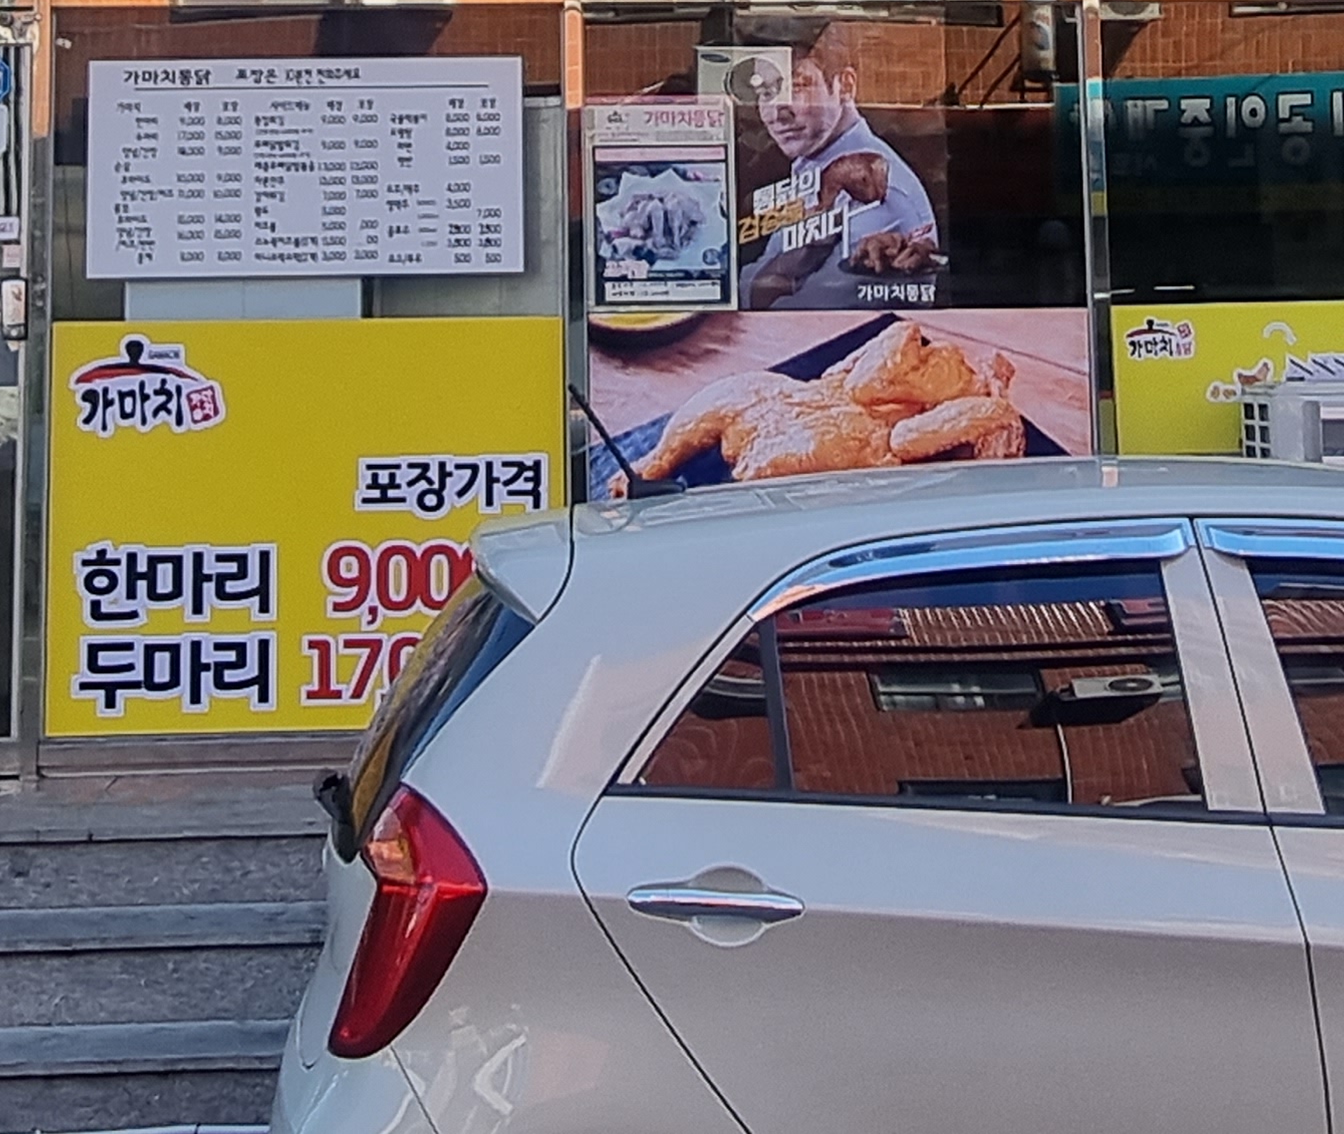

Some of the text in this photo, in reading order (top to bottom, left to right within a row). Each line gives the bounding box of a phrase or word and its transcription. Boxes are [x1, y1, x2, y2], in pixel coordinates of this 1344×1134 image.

[123, 68, 212, 86] 가마치통닭
[857, 282, 937, 302] 가마치통닭
[1128, 334, 1173, 358] 가마치
[81, 378, 184, 432] 가마치
[360, 459, 544, 514] 포장가격
[80, 544, 476, 626] 한마리 9,00
[78, 638, 272, 710] 두마리
